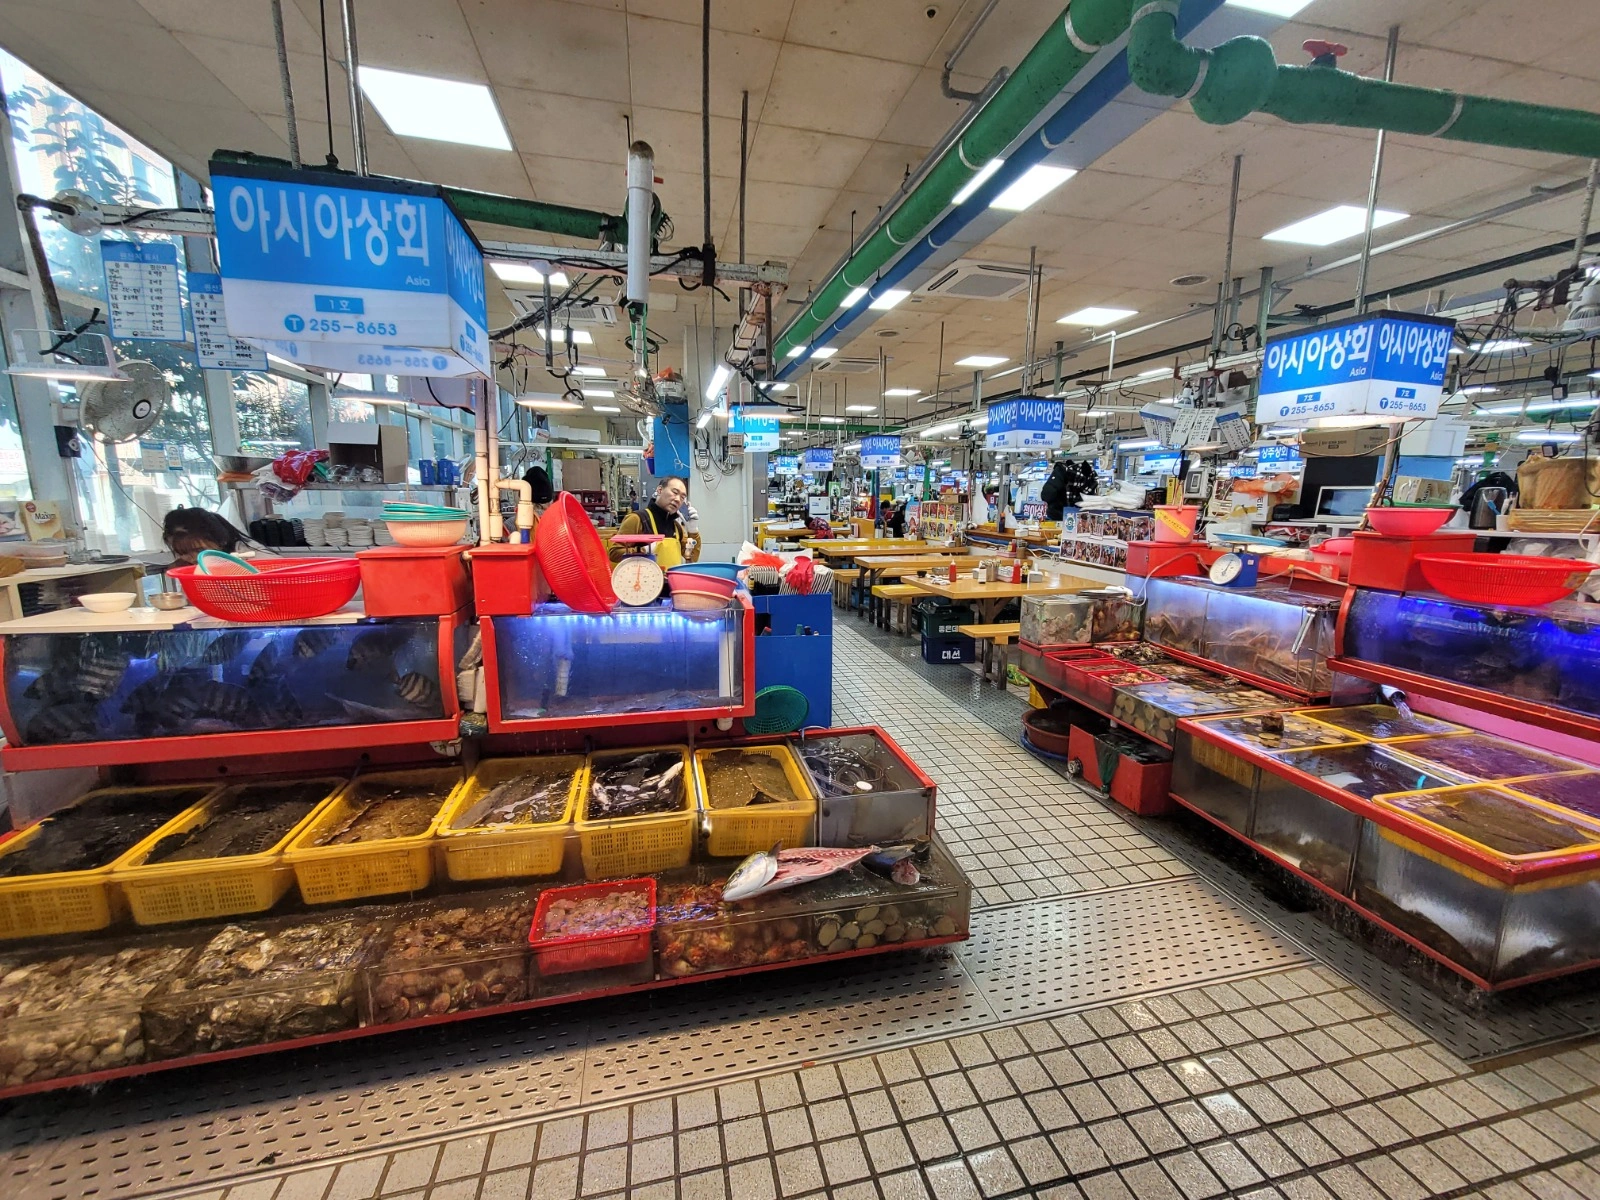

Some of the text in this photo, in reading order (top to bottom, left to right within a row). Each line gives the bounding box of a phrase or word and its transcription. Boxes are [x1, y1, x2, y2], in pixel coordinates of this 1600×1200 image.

[230, 185, 429, 267] 아시아상회
[405, 275, 430, 287] Asia
[309, 318, 397, 336] 255-8653
[1267, 324, 1374, 378] 아시아상회
[1379, 323, 1451, 369] 아시아상회
[1349, 367, 1367, 377] Asia
[1430, 371, 1443, 381] Asia
[1020, 401, 1063, 424] 아시아상회
[1291, 403, 1335, 415] 255-8653
[1389, 400, 1427, 412] 255-8653
[989, 402, 1018, 426] 아시아상회
[1261, 446, 1288, 459] 상주상회
[942, 648, 961, 659] 대선
